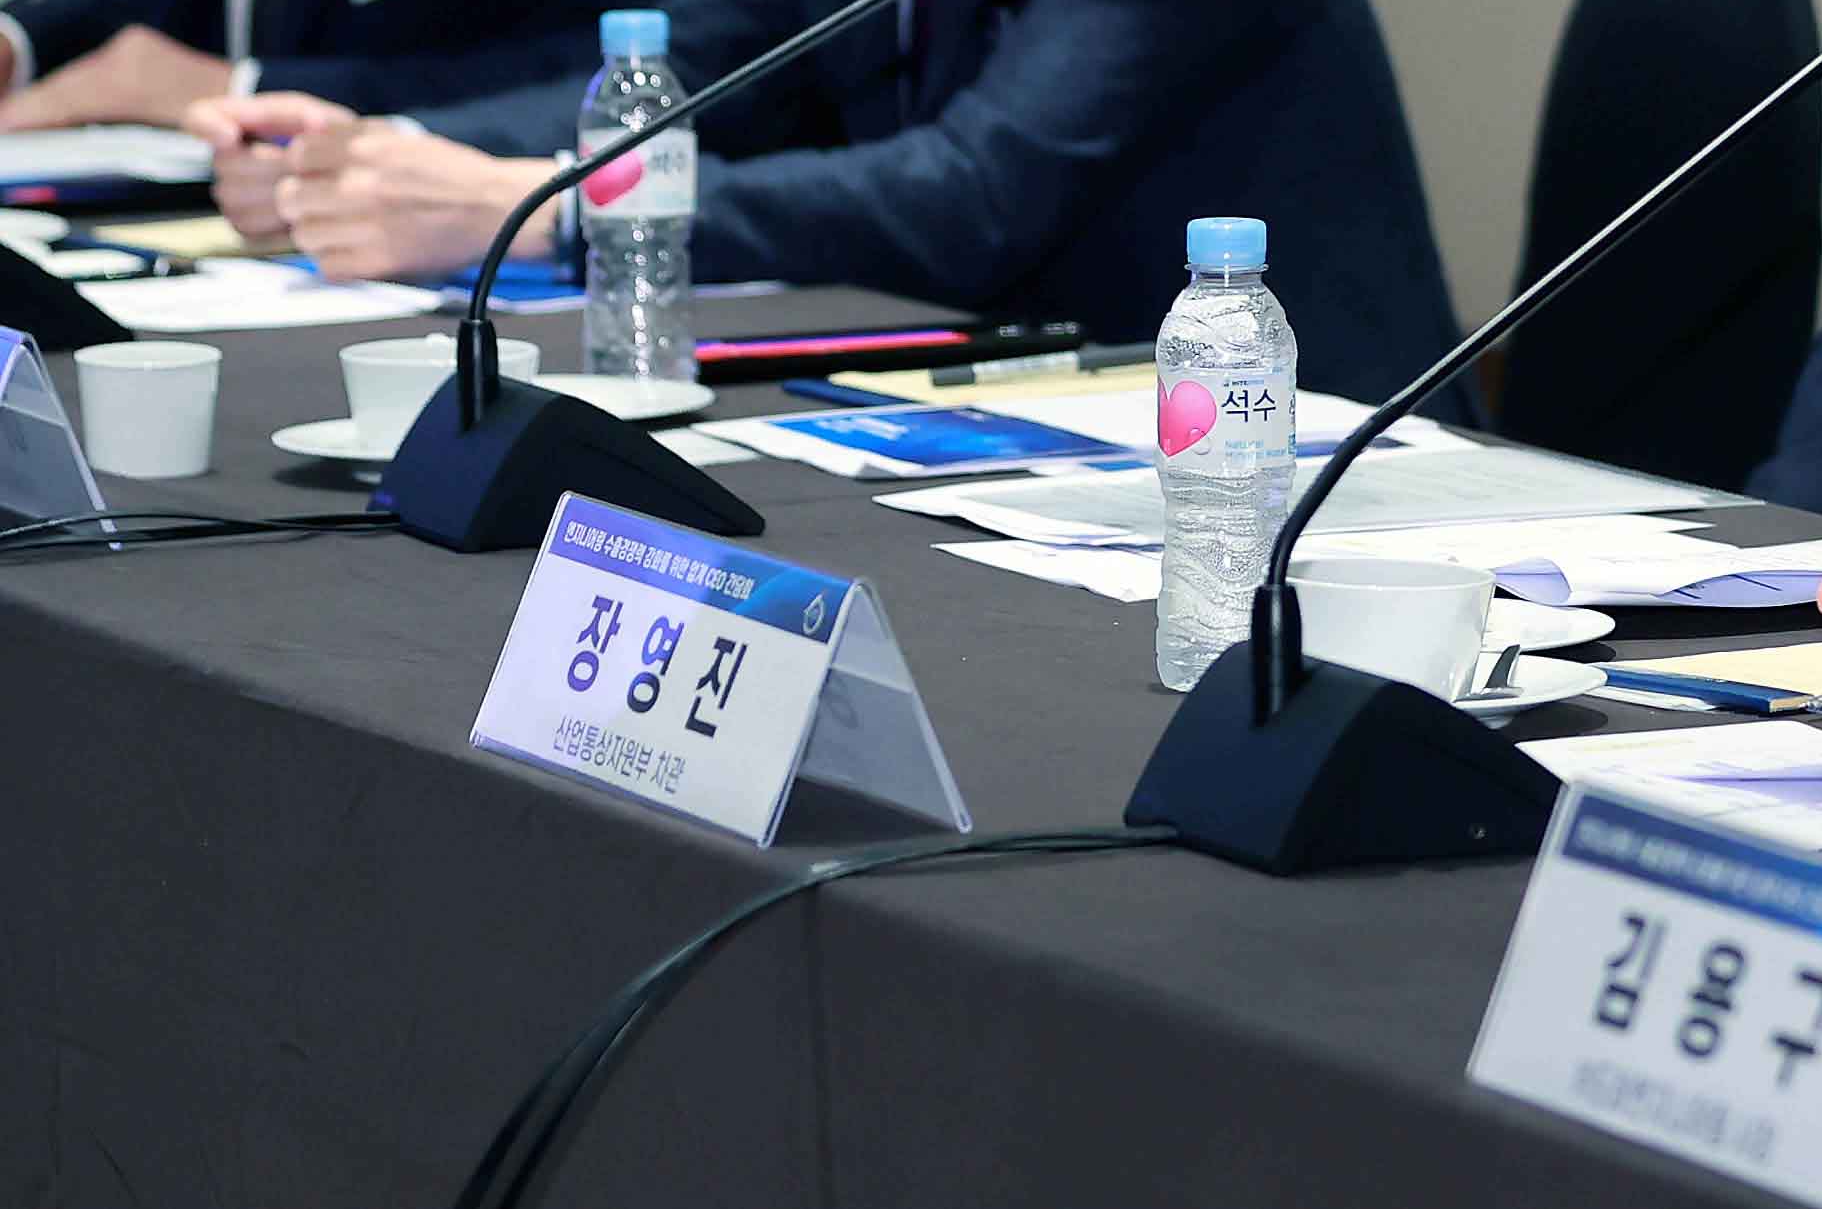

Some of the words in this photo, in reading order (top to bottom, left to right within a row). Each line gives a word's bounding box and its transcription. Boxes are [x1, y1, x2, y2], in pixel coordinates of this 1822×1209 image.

[1221, 389, 1276, 422] 석수
[564, 522, 605, 552] 엔지니어링
[605, 534, 645, 565] 수출경쟁력
[645, 546, 671, 573] 강화를
[671, 555, 688, 578] 위한
[706, 568, 725, 590] CEO
[726, 574, 754, 599] 간담회
[567, 595, 747, 737] 장영진
[554, 717, 652, 778] 산업통상자원부
[651, 751, 685, 793] 차관
